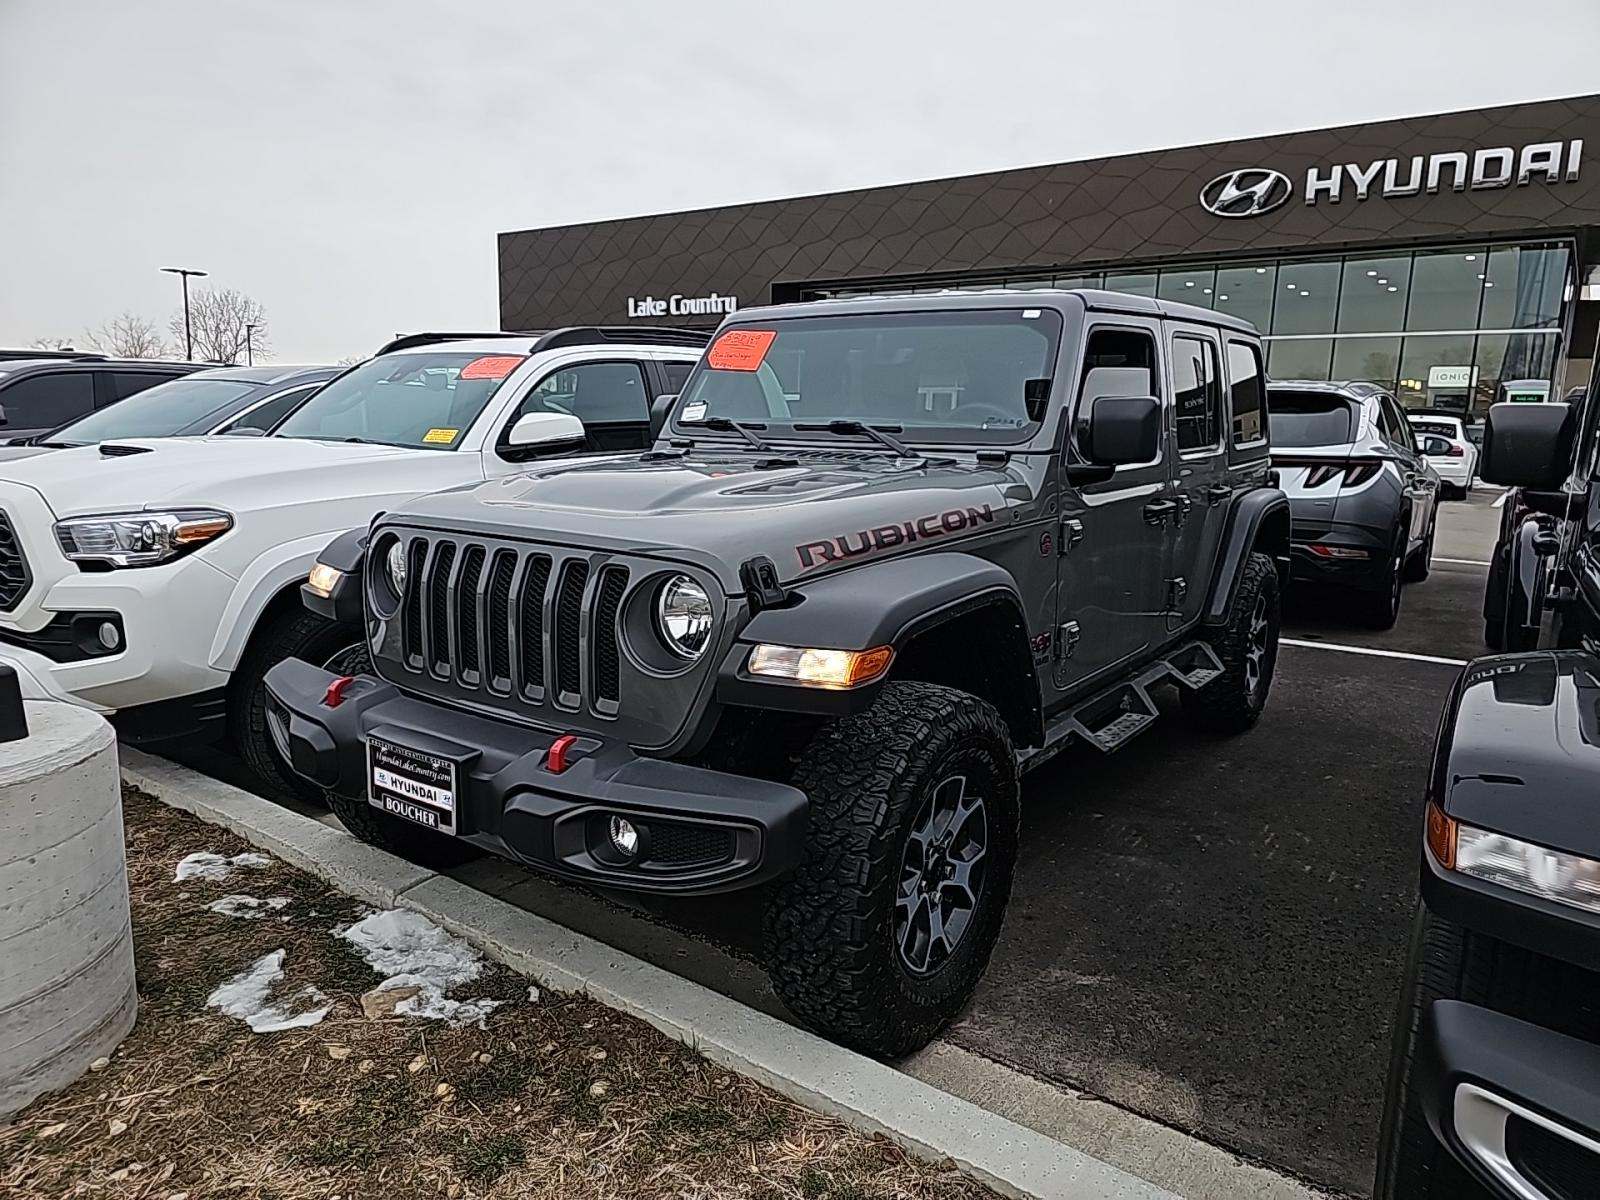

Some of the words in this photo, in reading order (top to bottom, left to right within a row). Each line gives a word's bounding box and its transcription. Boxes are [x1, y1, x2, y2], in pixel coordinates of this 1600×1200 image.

[1304, 139, 1584, 206] HYUNDAI
[628, 296, 667, 317] Lake
[669, 293, 737, 315] Country
[795, 503, 995, 569] RUBICON
[390, 776, 437, 802] HYUNDAI
[386, 797, 435, 826] BOUCHER
